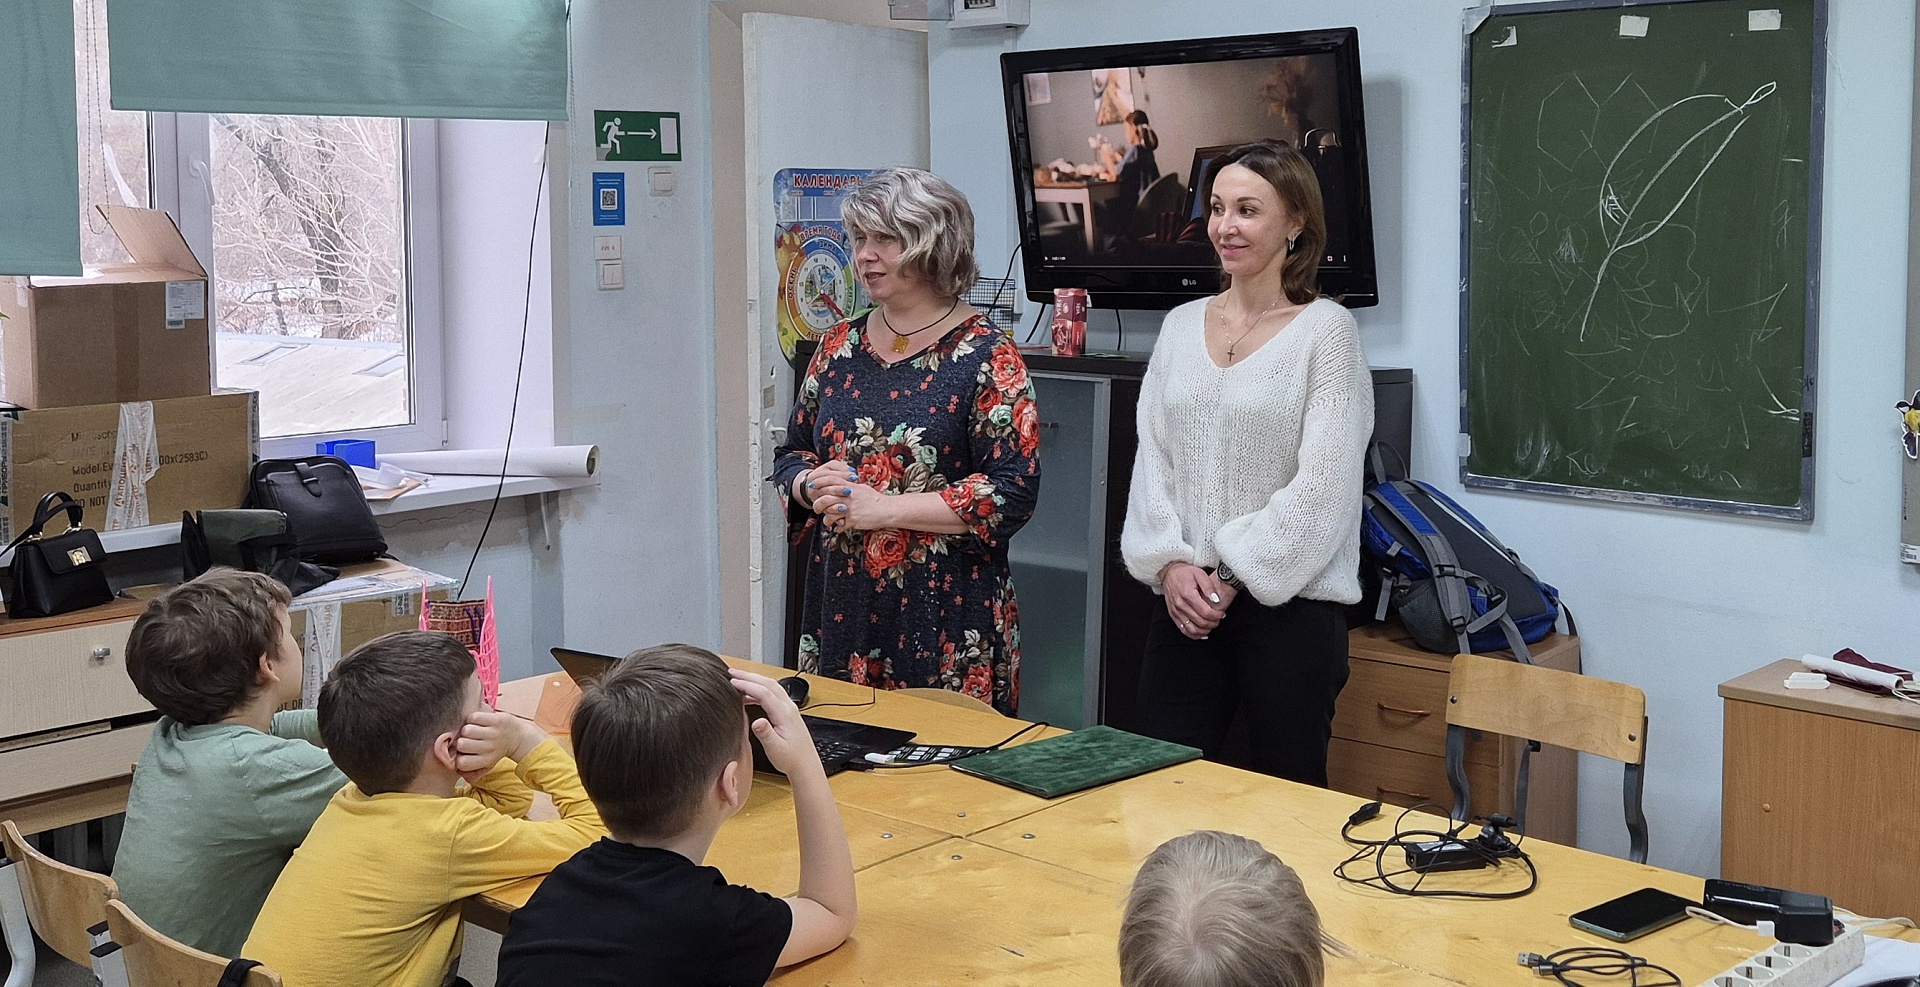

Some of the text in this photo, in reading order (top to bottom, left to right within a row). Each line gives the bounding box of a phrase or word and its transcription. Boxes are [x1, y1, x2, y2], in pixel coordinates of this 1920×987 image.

[793, 173, 863, 190] КАЛЕНДАРЬ
[800, 225, 842, 243] ВРЕМЯ ГОДА
[789, 266, 797, 299] ОСЕНЬ
[89, 495, 106, 507] NOT
